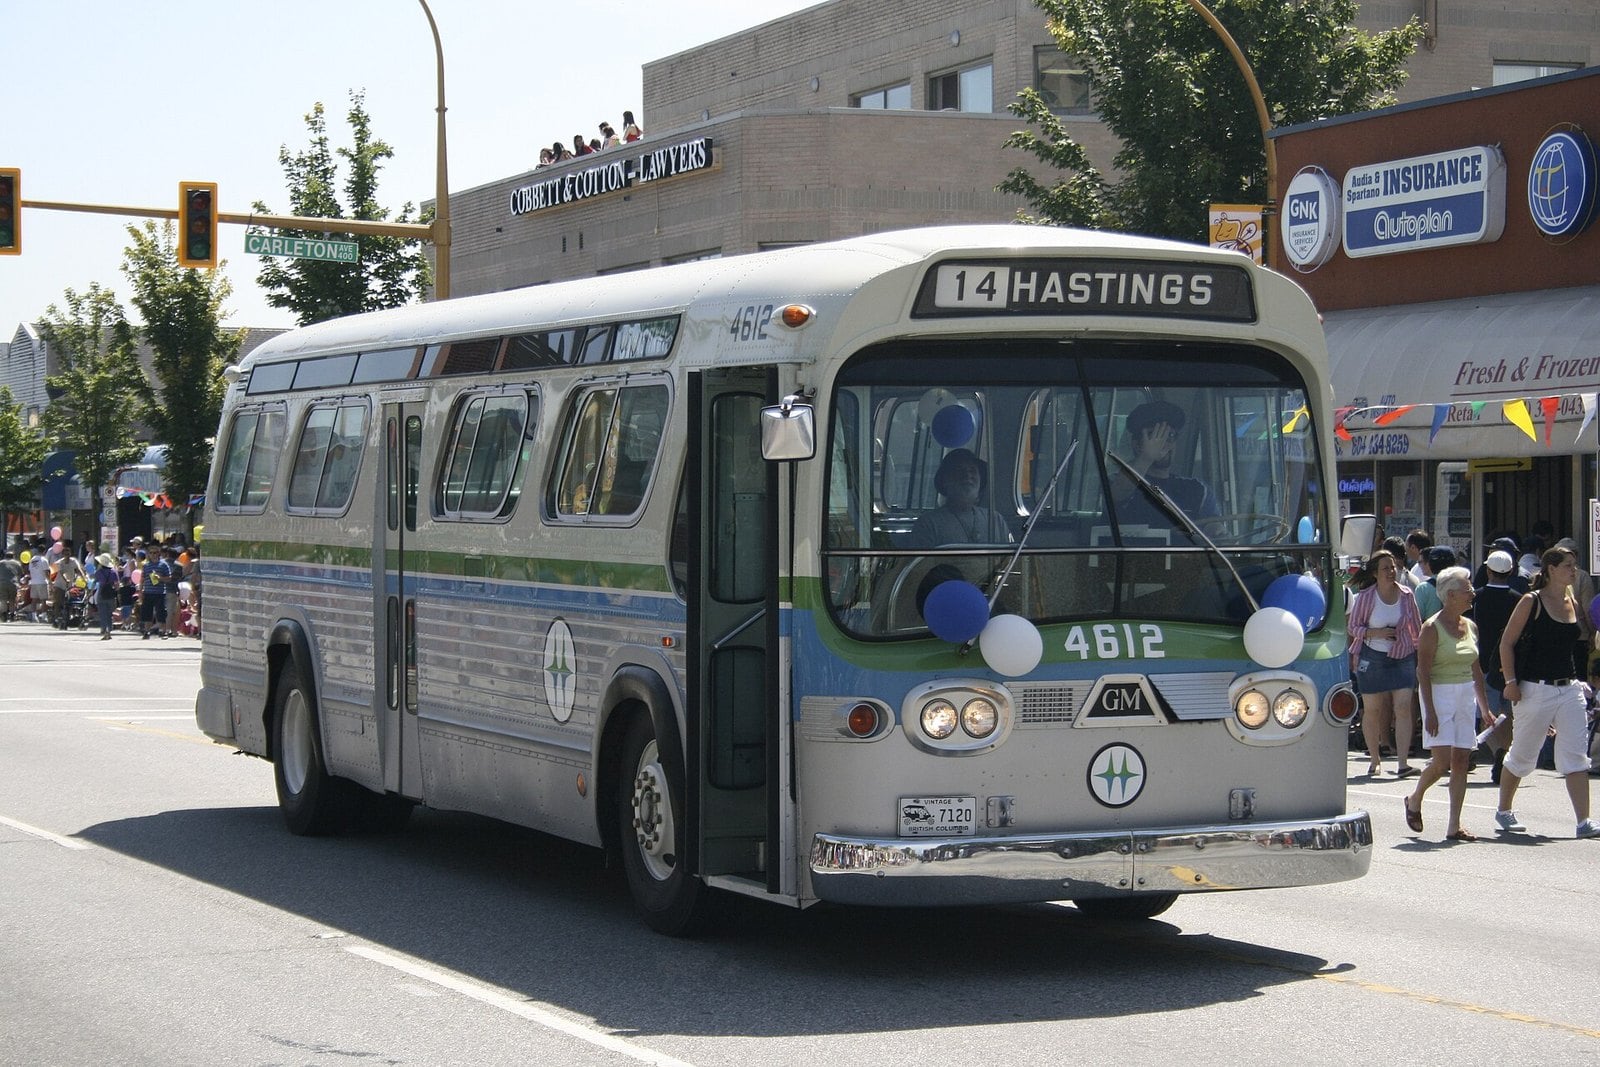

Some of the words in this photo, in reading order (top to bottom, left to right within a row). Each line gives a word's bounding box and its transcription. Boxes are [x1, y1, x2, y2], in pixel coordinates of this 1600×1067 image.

[509, 177, 563, 216] COBBETT
[563, 176, 574, 203] &
[574, 159, 626, 200] COTTON
[638, 137, 707, 184] LAWYERS
[1351, 172, 1373, 188] Audia
[1374, 171, 1380, 184] &
[1382, 153, 1482, 197] INSURANCE
[1346, 186, 1380, 204] Spartano
[1290, 198, 1318, 220] GNK
[1291, 229, 1317, 239] INSURANCE
[1294, 237, 1314, 247] SERVICES
[248, 236, 338, 259] CARLETON
[337, 252, 353, 261] 400
[338, 245, 353, 253] AVE
[955, 270, 997, 302] 14
[1012, 271, 1213, 306] HASTINGS
[730, 304, 774, 342] 4612
[1453, 358, 1508, 386] Fresh
[1510, 356, 1530, 382] &
[1532, 355, 1600, 381] Frozen
[1447, 404, 1480, 422] Reta
[1064, 623, 1166, 660] 4612
[1101, 688, 1141, 711] GM
[939, 808, 972, 823] 7120
